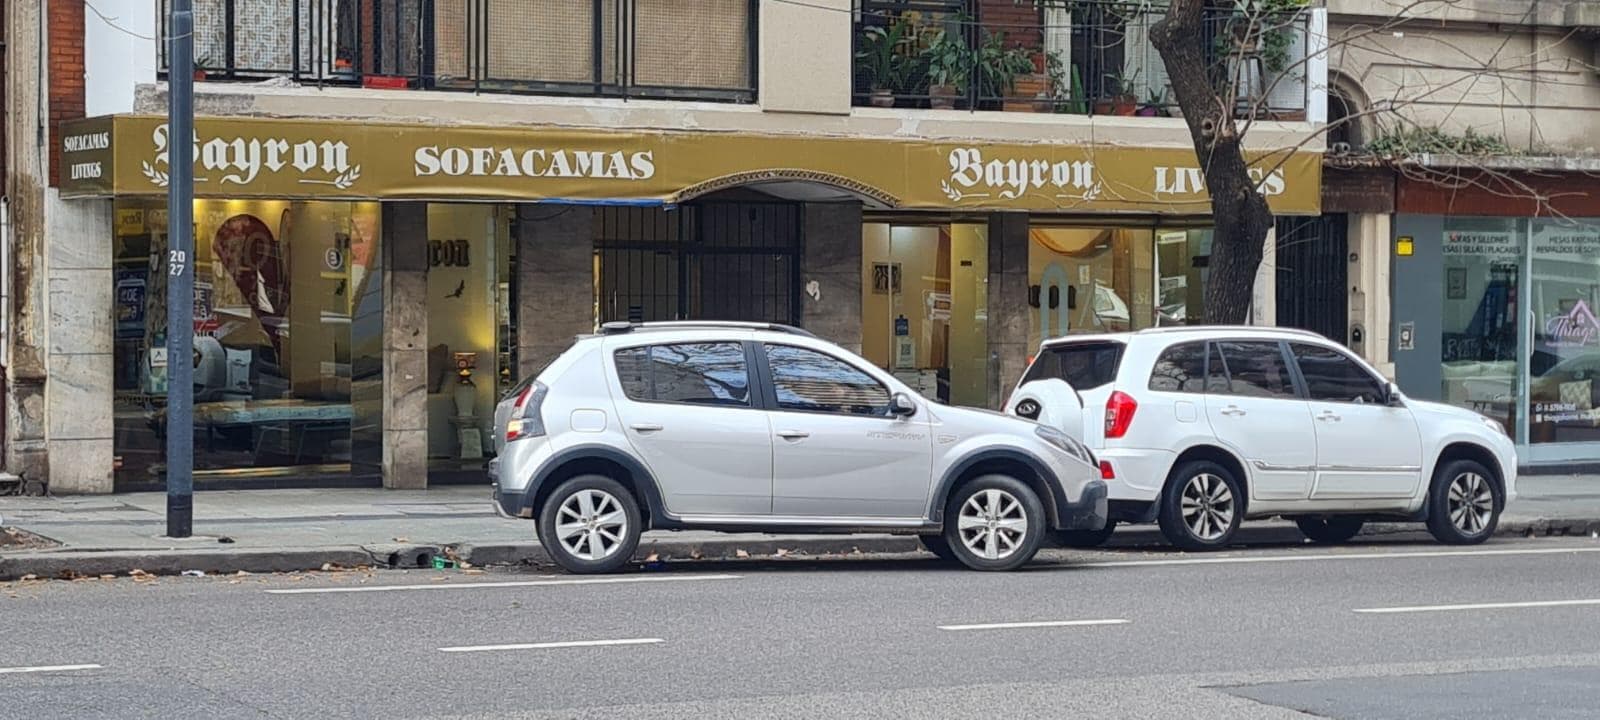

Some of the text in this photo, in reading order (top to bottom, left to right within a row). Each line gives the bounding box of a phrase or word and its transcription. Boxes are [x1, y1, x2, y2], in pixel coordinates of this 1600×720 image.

[64, 132, 109, 152] SOFACAMAS
[72, 162, 102, 179] LIVINGS
[415, 146, 655, 180] SOFACAMAS
[949, 148, 1094, 199] Bayron
[1154, 166, 1286, 195] LIVS
[170, 250, 185, 262] 20
[170, 264, 185, 276] 27
